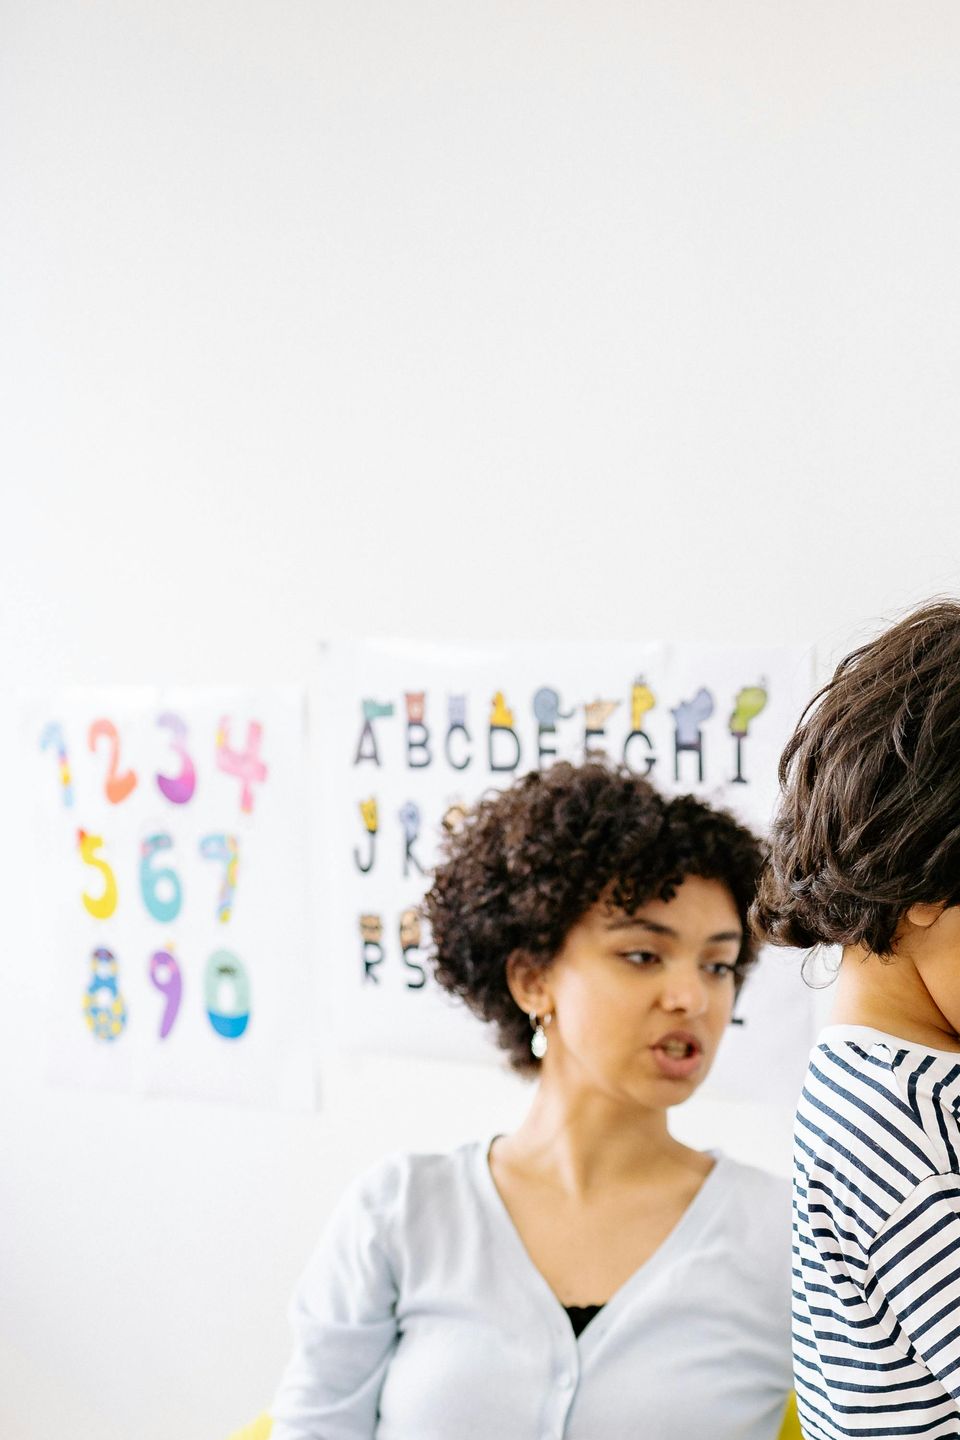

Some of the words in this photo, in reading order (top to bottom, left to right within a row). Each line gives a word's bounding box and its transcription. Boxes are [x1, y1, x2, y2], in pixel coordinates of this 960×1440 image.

[88, 717, 138, 805] 2
[156, 712, 197, 805] 3
[216, 715, 268, 814] 4
[354, 719, 381, 767] A
[406, 722, 432, 768] B
[445, 723, 471, 770] C
[489, 725, 521, 771] D
[622, 729, 656, 777] G
[674, 729, 703, 782] H
[731, 732, 748, 783] I
[78, 829, 119, 920] 5
[140, 833, 183, 924] 6
[200, 834, 239, 924] 7
[354, 830, 376, 873] J
[83, 947, 128, 1042] 8
[150, 951, 183, 1040] 9
[205, 949, 250, 1039] 0
[362, 941, 384, 984] R
[402, 944, 426, 989] S
